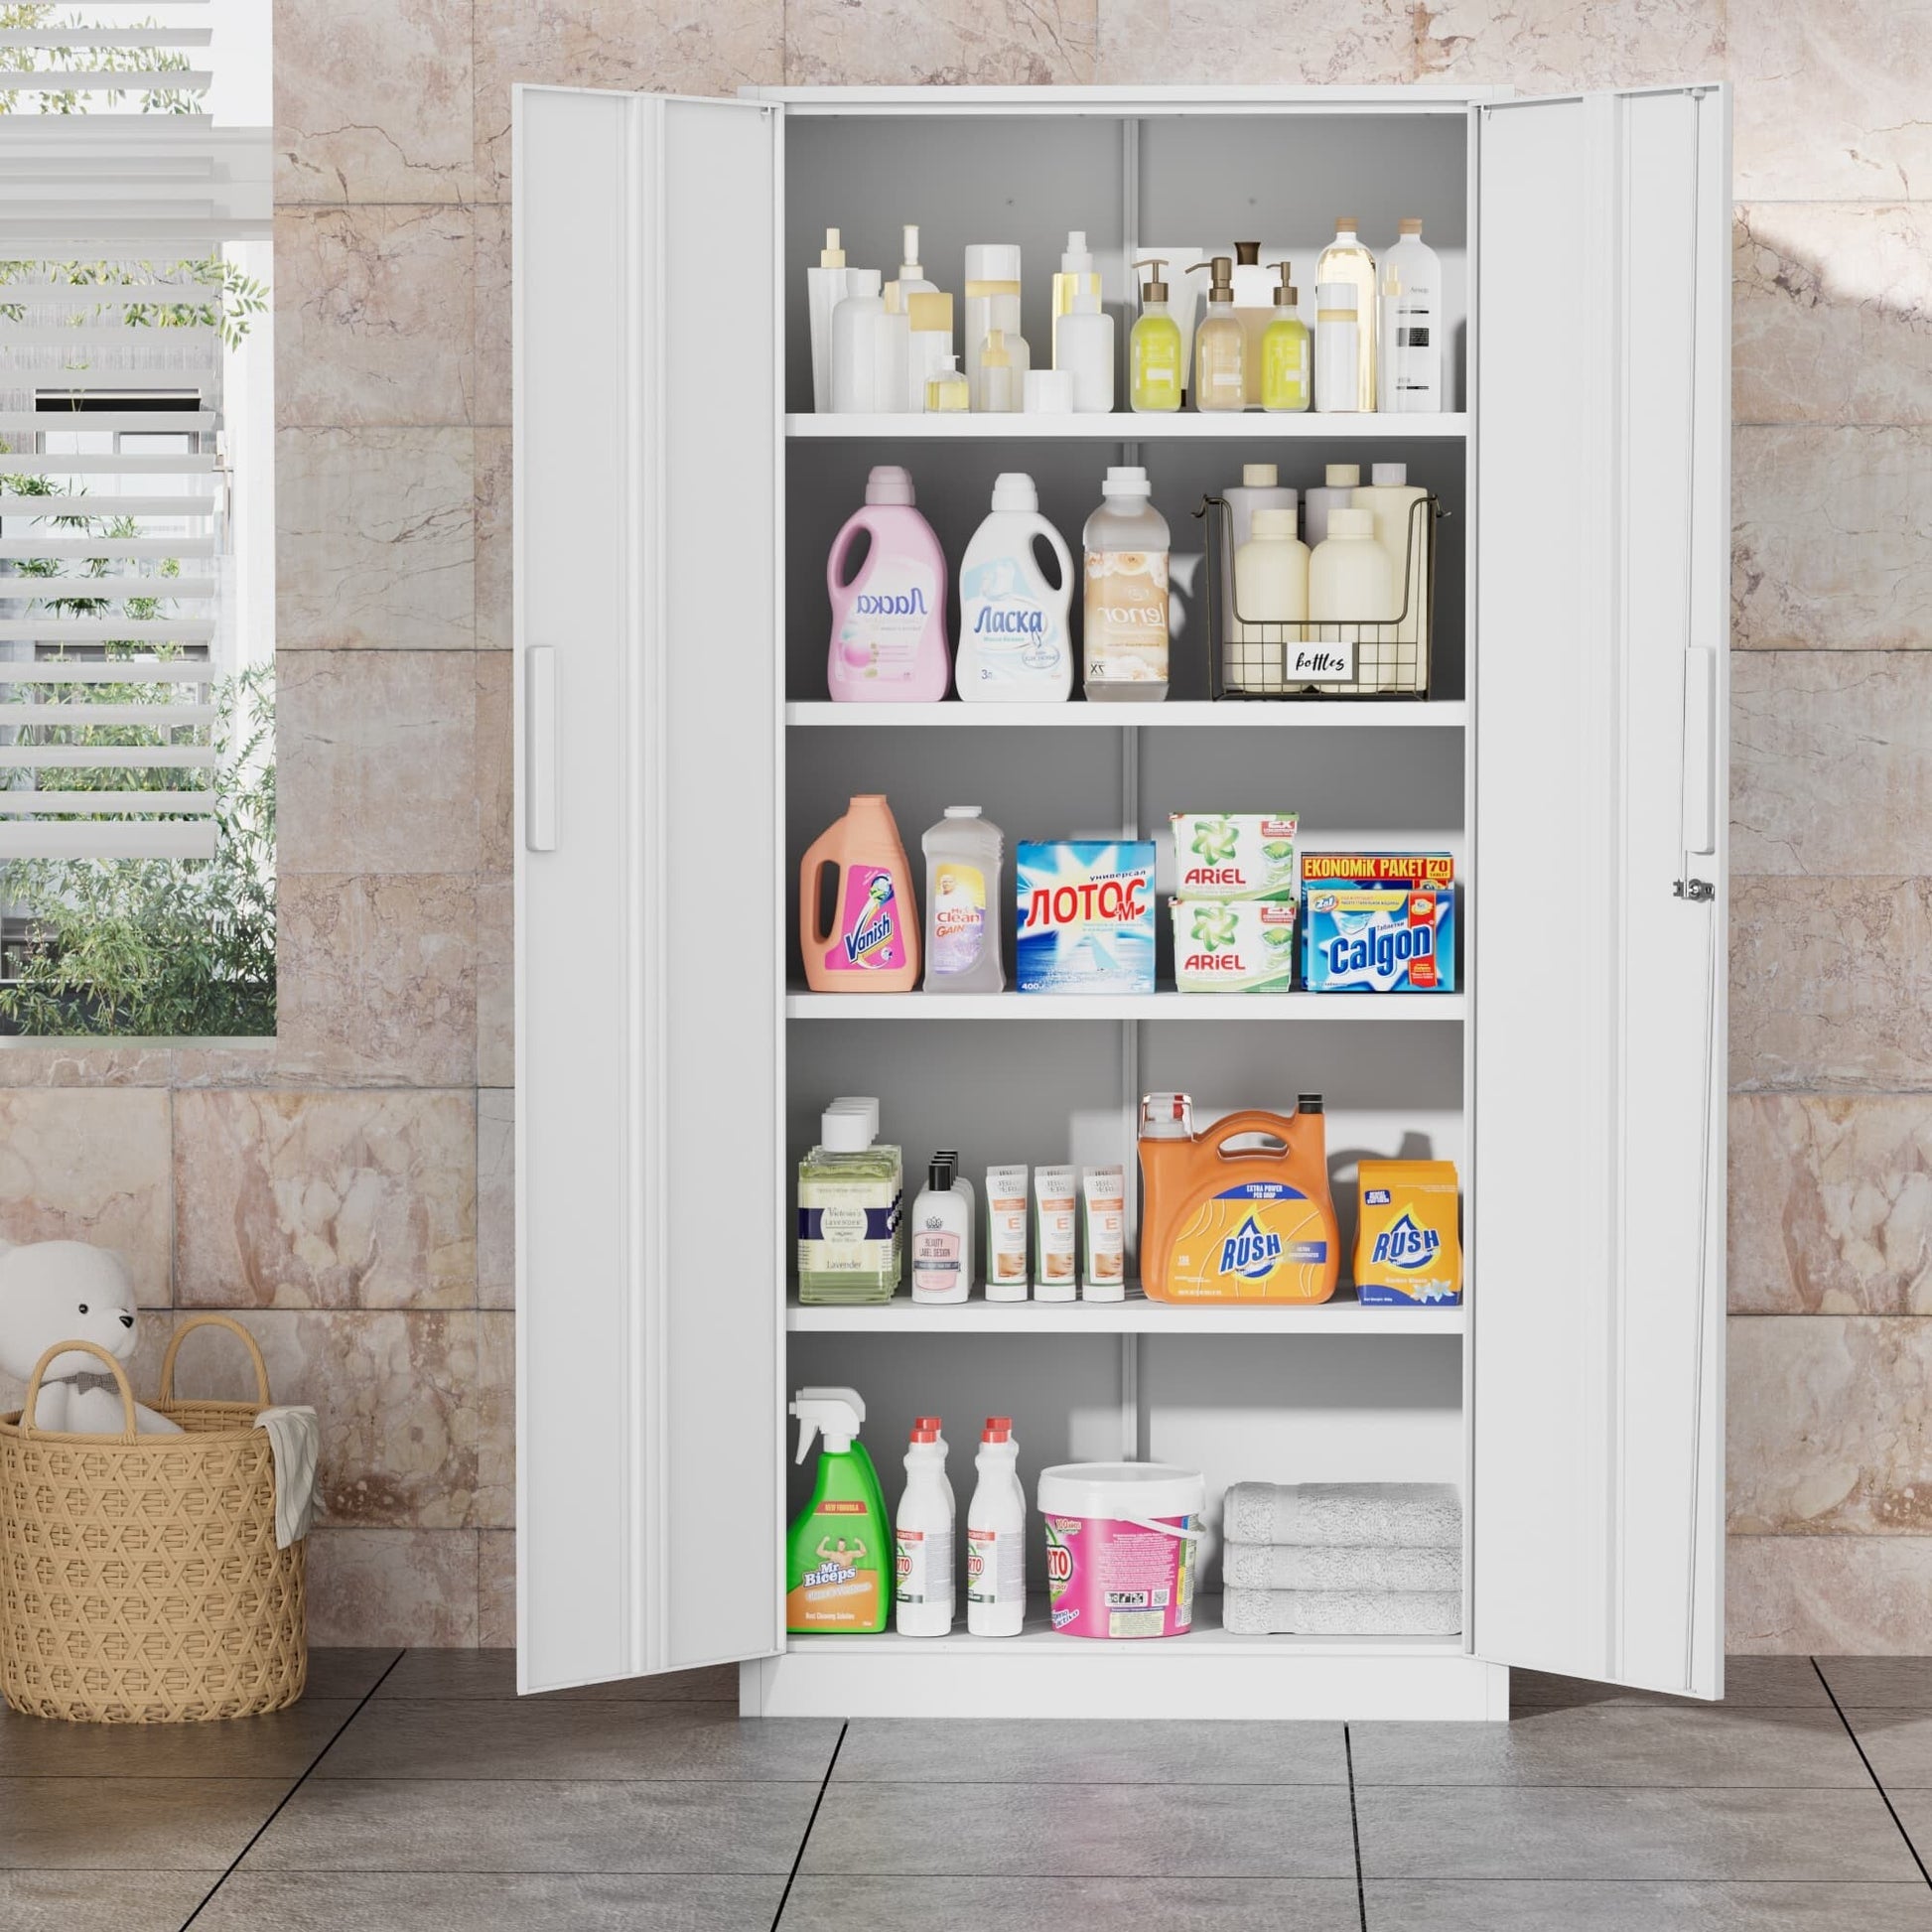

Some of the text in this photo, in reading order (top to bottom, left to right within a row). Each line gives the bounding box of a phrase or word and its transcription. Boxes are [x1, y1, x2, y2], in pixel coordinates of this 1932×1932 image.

[974, 605, 1042, 633] Ласка
[1295, 651, 1345, 672] bottles
[1380, 858, 1425, 877] PAKET
[1429, 860, 1449, 873] 70
[1089, 869, 1147, 883] универсал
[1027, 878, 1146, 927] ЛОТОС
[936, 911, 980, 923] Clean
[845, 911, 892, 961] Vanish
[936, 924, 965, 938] GAIN
[1329, 925, 1431, 977] Calgon
[1008, 1217, 1022, 1230] E
[1056, 1217, 1069, 1230] E
[1105, 1217, 1119, 1230] E
[924, 1238, 943, 1248] BEAUTY
[1372, 1229, 1441, 1263] RUSH
[933, 1248, 951, 1258] DESIGN
[1219, 1233, 1282, 1274] RUSH
[826, 1259, 862, 1269] Lavender
[804, 1567, 856, 1587] Biceps
